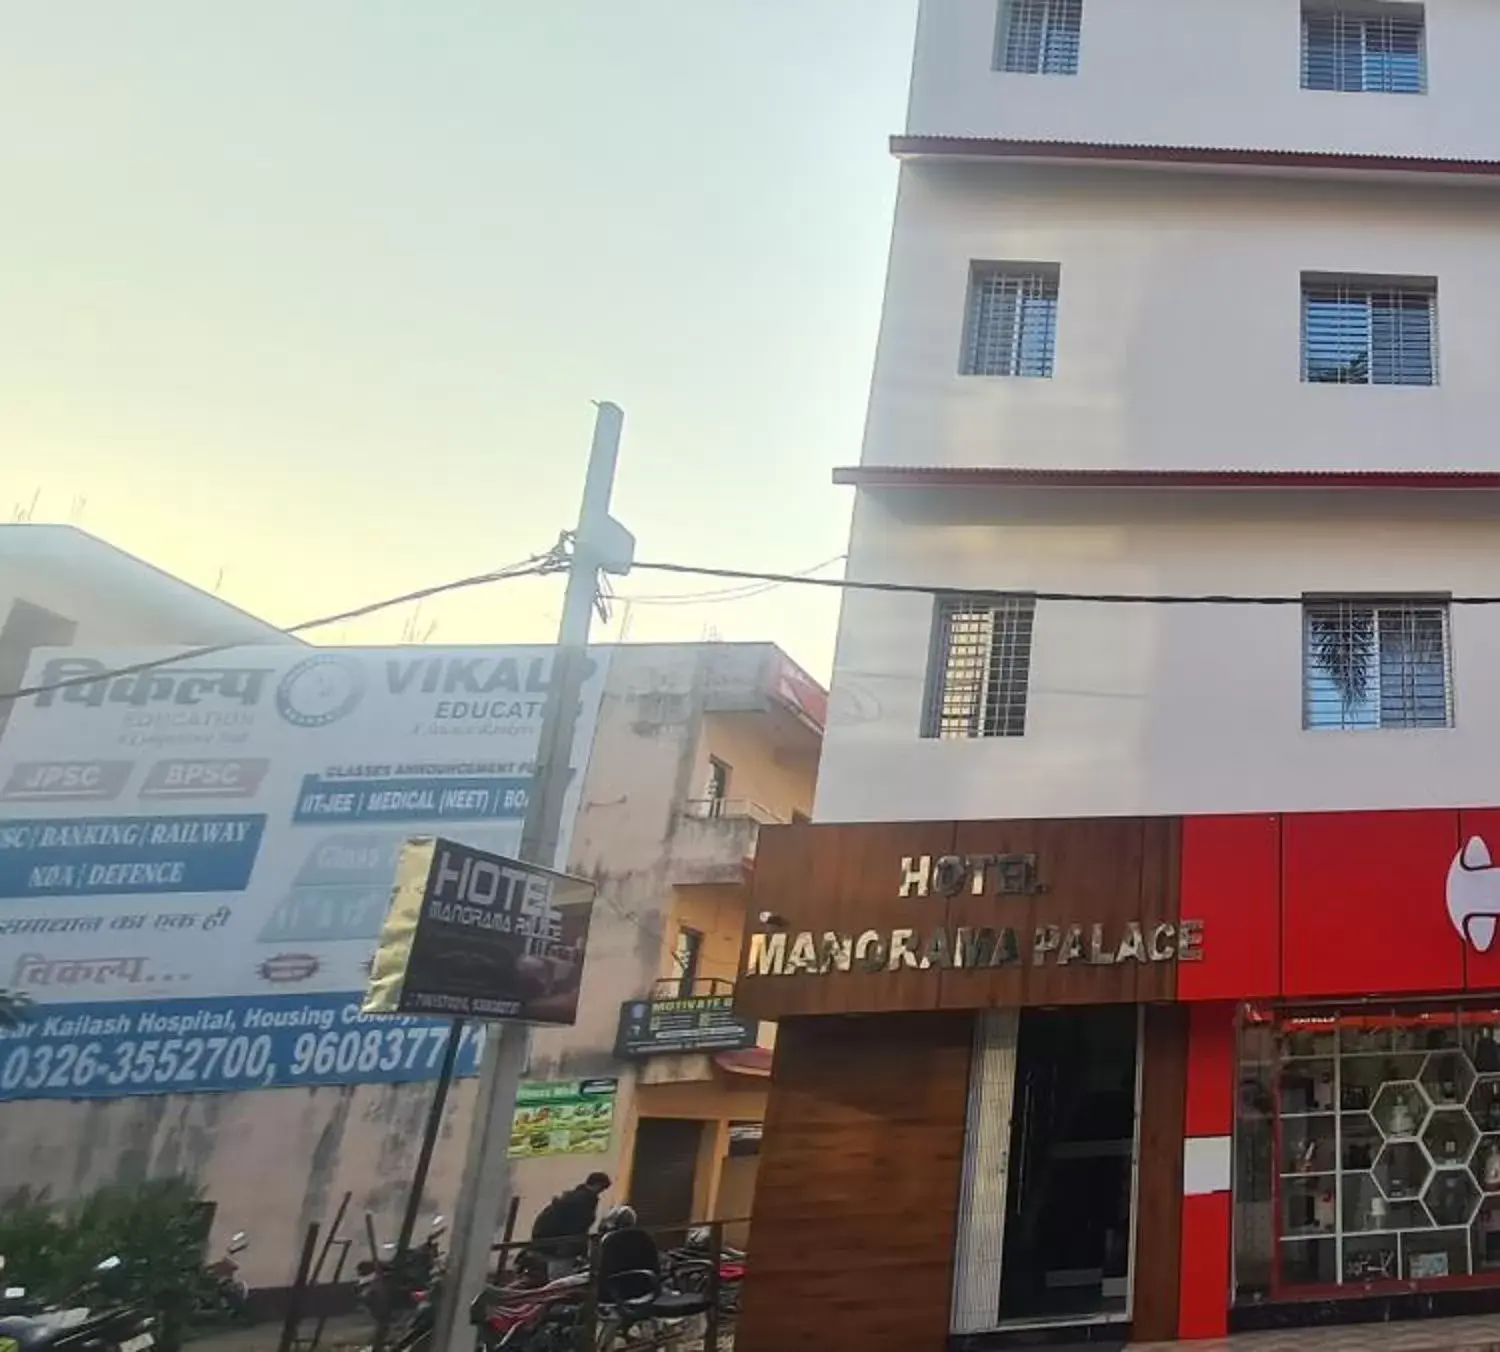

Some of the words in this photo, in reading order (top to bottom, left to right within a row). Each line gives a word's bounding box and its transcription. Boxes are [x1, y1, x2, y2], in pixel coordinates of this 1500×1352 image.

[34, 657, 275, 707] विकल्प
[433, 700, 583, 719] EDUCAT
[25, 766, 102, 788] JPSC
[165, 763, 241, 786] BPSC
[367, 789, 434, 812] MEDICAL
[504, 789, 530, 809] BO
[432, 851, 563, 921] HOTEL
[898, 854, 1047, 897] HOTEL
[745, 925, 1022, 977] MANORAMA
[1031, 918, 1205, 967] PALACE
[41, 1014, 131, 1038] Kailash
[138, 1008, 237, 1036] Hospital,
[243, 1004, 336, 1030] Housing
